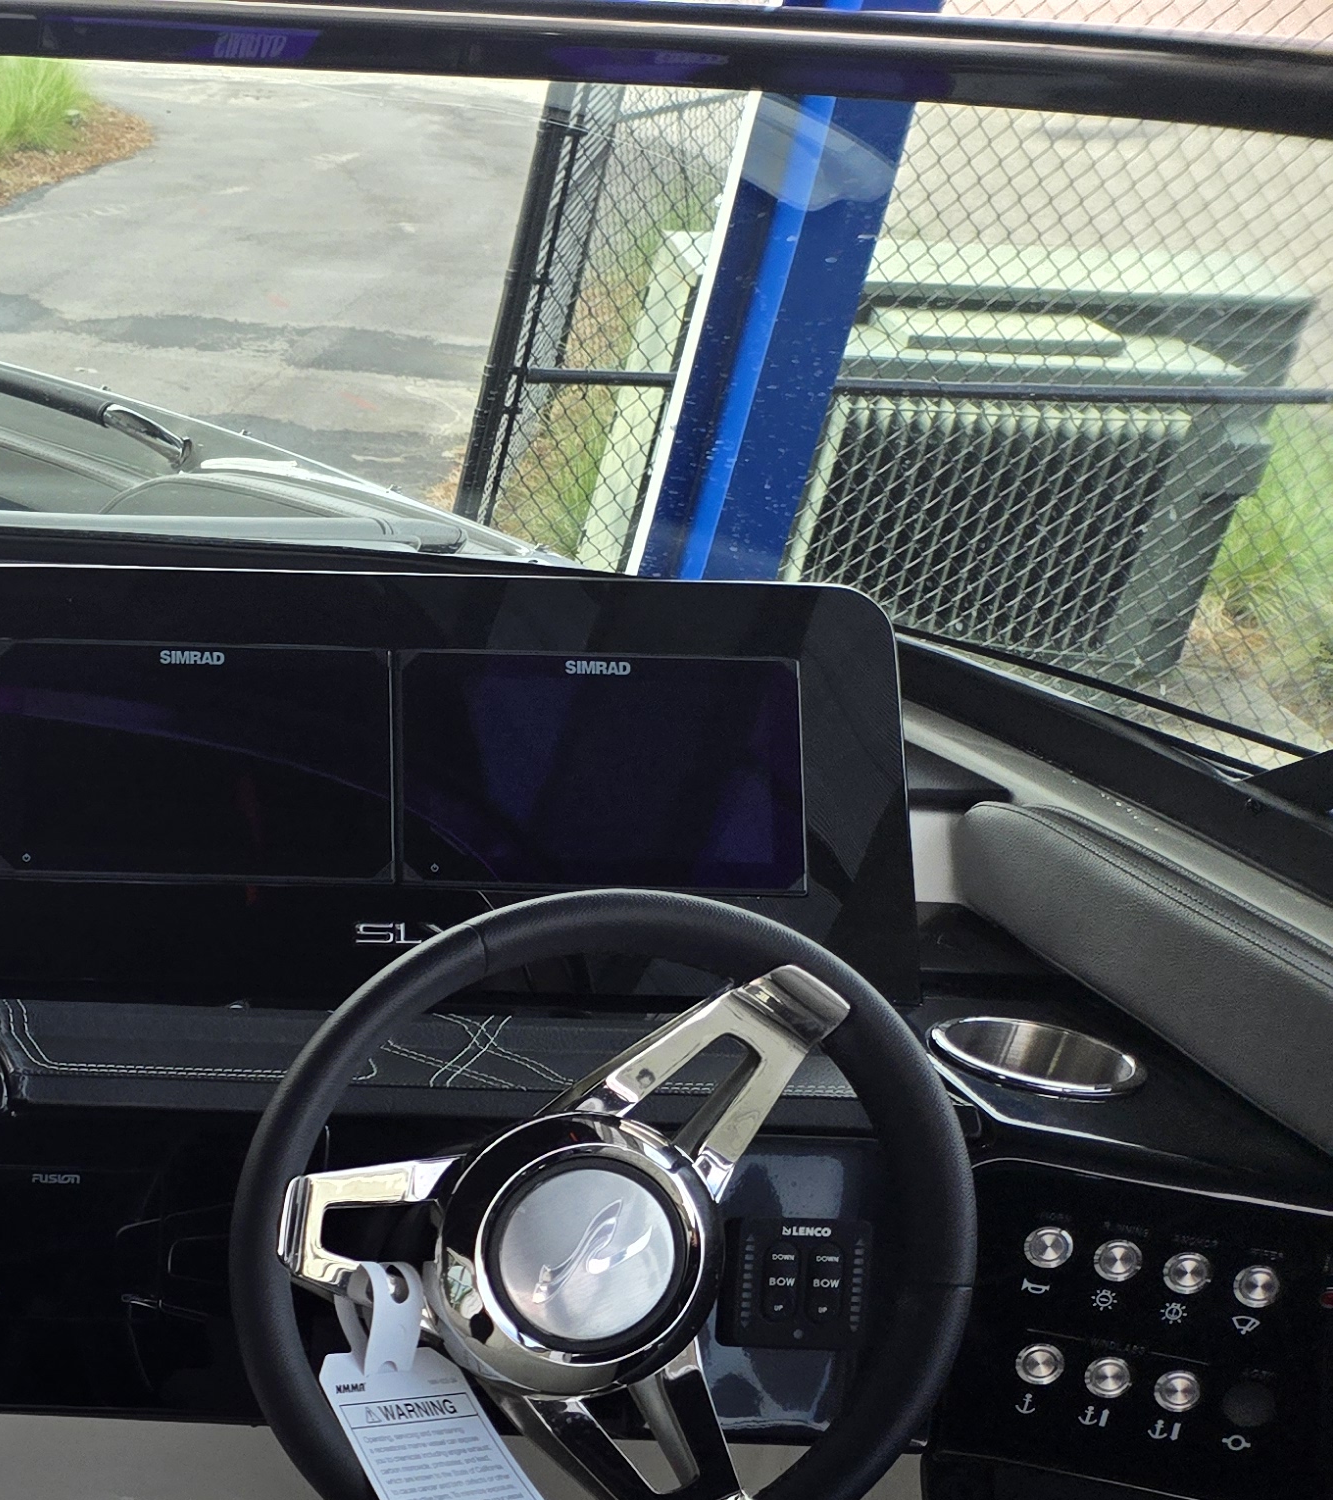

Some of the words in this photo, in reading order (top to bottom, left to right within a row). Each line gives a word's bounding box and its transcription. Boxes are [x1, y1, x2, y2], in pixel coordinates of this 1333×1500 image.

[159, 650, 225, 665] SIMRAD
[565, 660, 631, 675] SIMRAD
[792, 1226, 832, 1237] LENCO
[769, 1277, 795, 1287] BOW
[813, 1278, 840, 1288] BOW
[378, 1399, 457, 1421] WARNING
